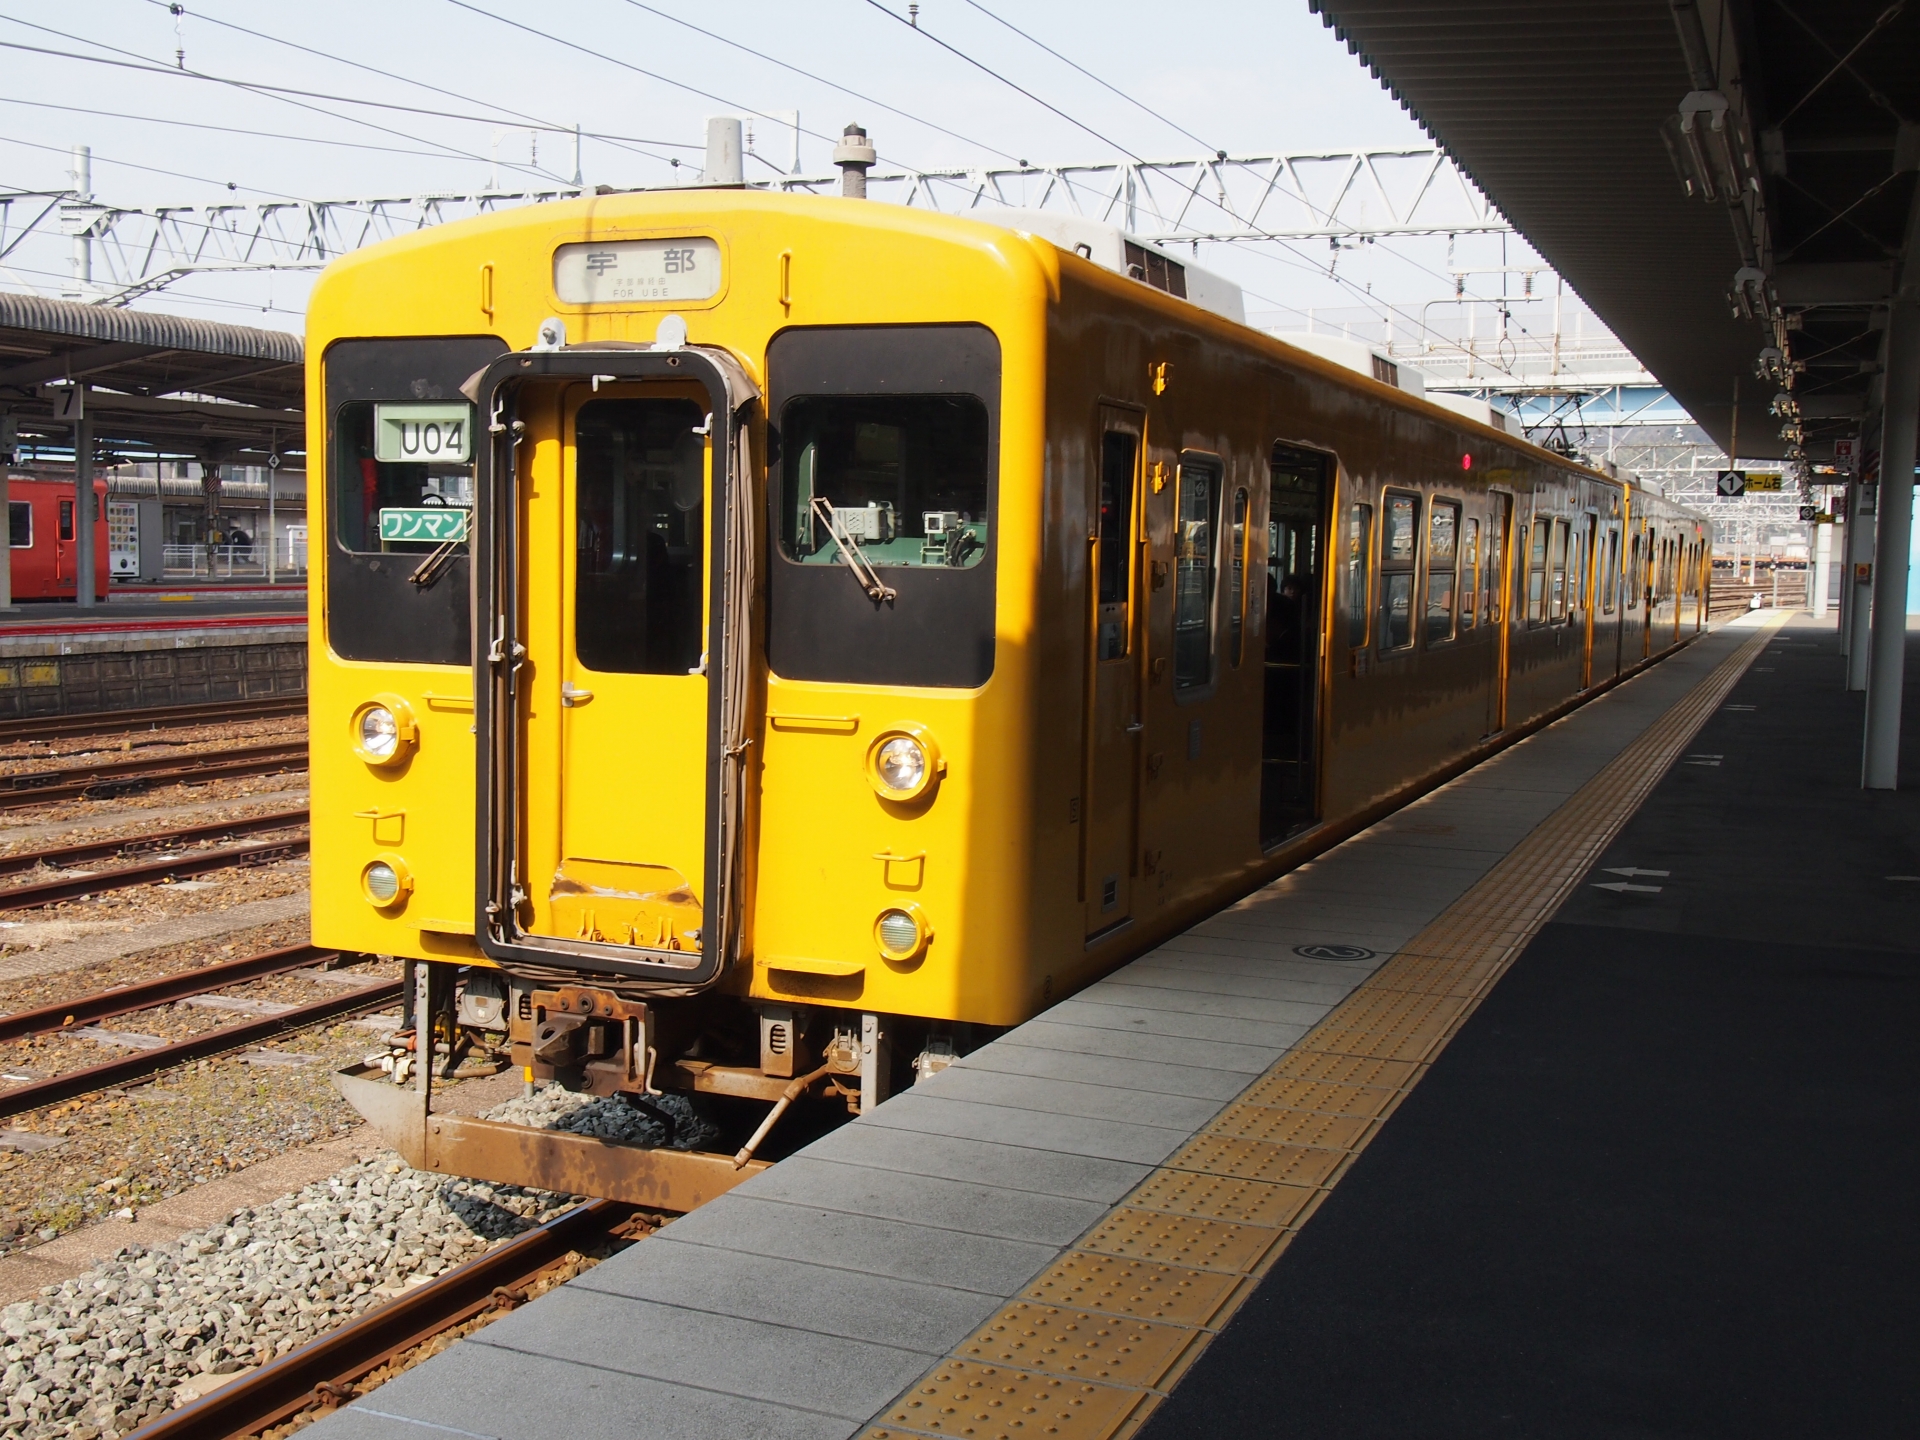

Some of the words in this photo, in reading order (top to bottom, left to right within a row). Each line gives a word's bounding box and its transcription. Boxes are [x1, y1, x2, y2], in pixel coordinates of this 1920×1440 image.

[586, 248, 696, 277] 宇部
[613, 289, 634, 298] FOR
[642, 287, 669, 297] UBE
[60, 389, 74, 415] 7
[401, 422, 463, 455] U04
[1726, 476, 1734, 491] 1
[1744, 477, 1781, 489] ホーム右
[1803, 508, 1811, 518] 3
[383, 512, 464, 538] ワンマン
